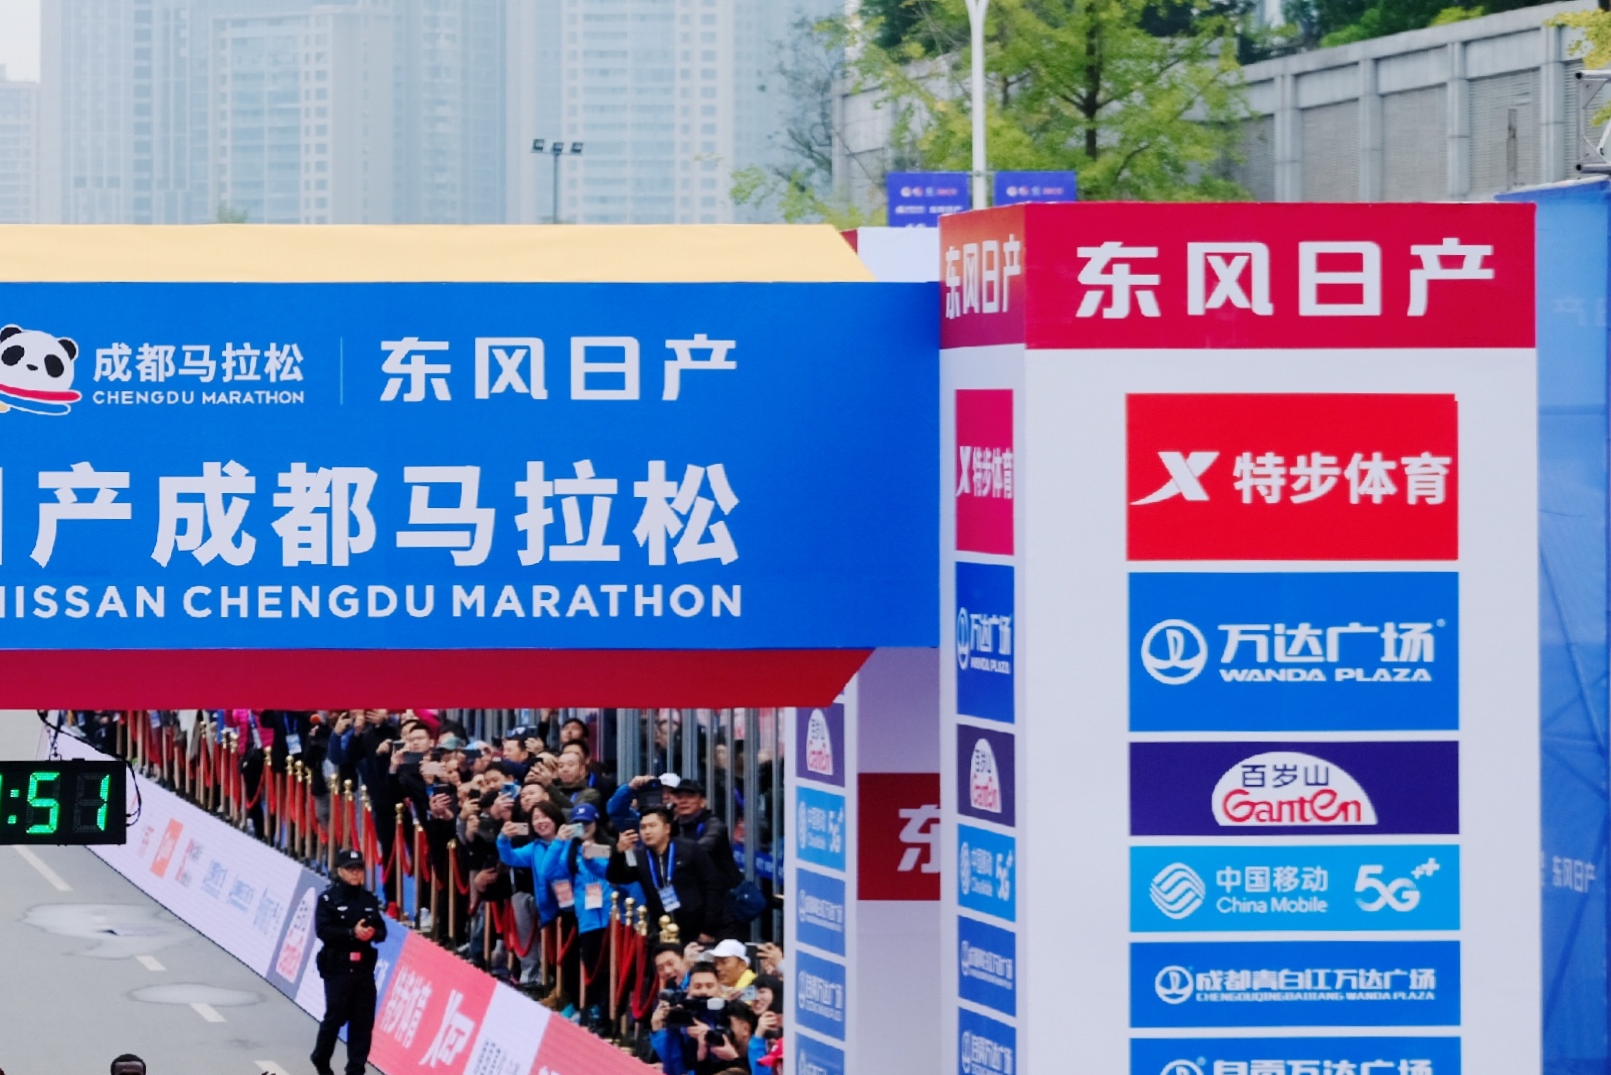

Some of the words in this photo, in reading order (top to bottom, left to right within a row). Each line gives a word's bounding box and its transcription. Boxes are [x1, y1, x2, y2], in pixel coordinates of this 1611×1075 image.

[945, 234, 1021, 319] 东风日产
[1075, 238, 1495, 319] 东风日产
[93, 341, 304, 384] 成都马拉松
[380, 334, 737, 402] 东风日产
[93, 390, 195, 405] CHENGDU
[202, 390, 305, 405] MARATHON
[1232, 451, 1452, 505] 特步体育
[183, 584, 435, 619] CHENGDU
[452, 583, 743, 618] MARATHON
[1217, 622, 1435, 663] 万达广场
[1219, 668, 1327, 682] WANDA
[1335, 668, 1433, 682] PLAZA
[1241, 763, 1331, 788] 百岁山
[1216, 865, 1329, 893] 中国移动
[1216, 896, 1268, 914] China
[1271, 896, 1328, 913] Mobile
[1196, 968, 1437, 991] 成都青白江万达广场
